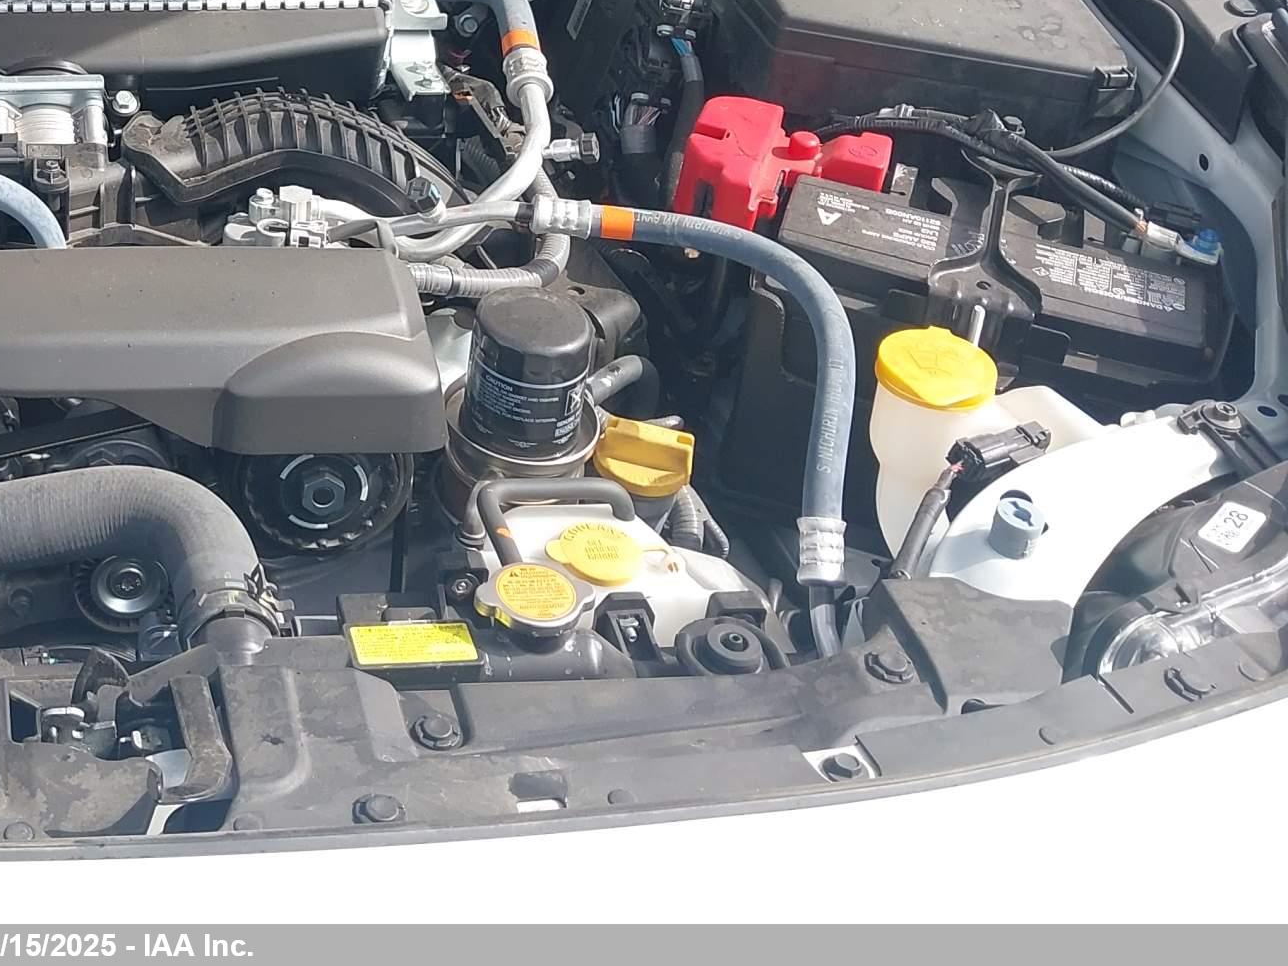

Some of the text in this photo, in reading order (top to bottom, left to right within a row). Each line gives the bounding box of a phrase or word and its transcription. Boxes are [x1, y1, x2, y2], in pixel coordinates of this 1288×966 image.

[485, 374, 513, 392] CAUTION
[817, 409, 839, 462] NICHIRIN
[816, 463, 832, 475] S
[1223, 510, 1249, 529] 28
